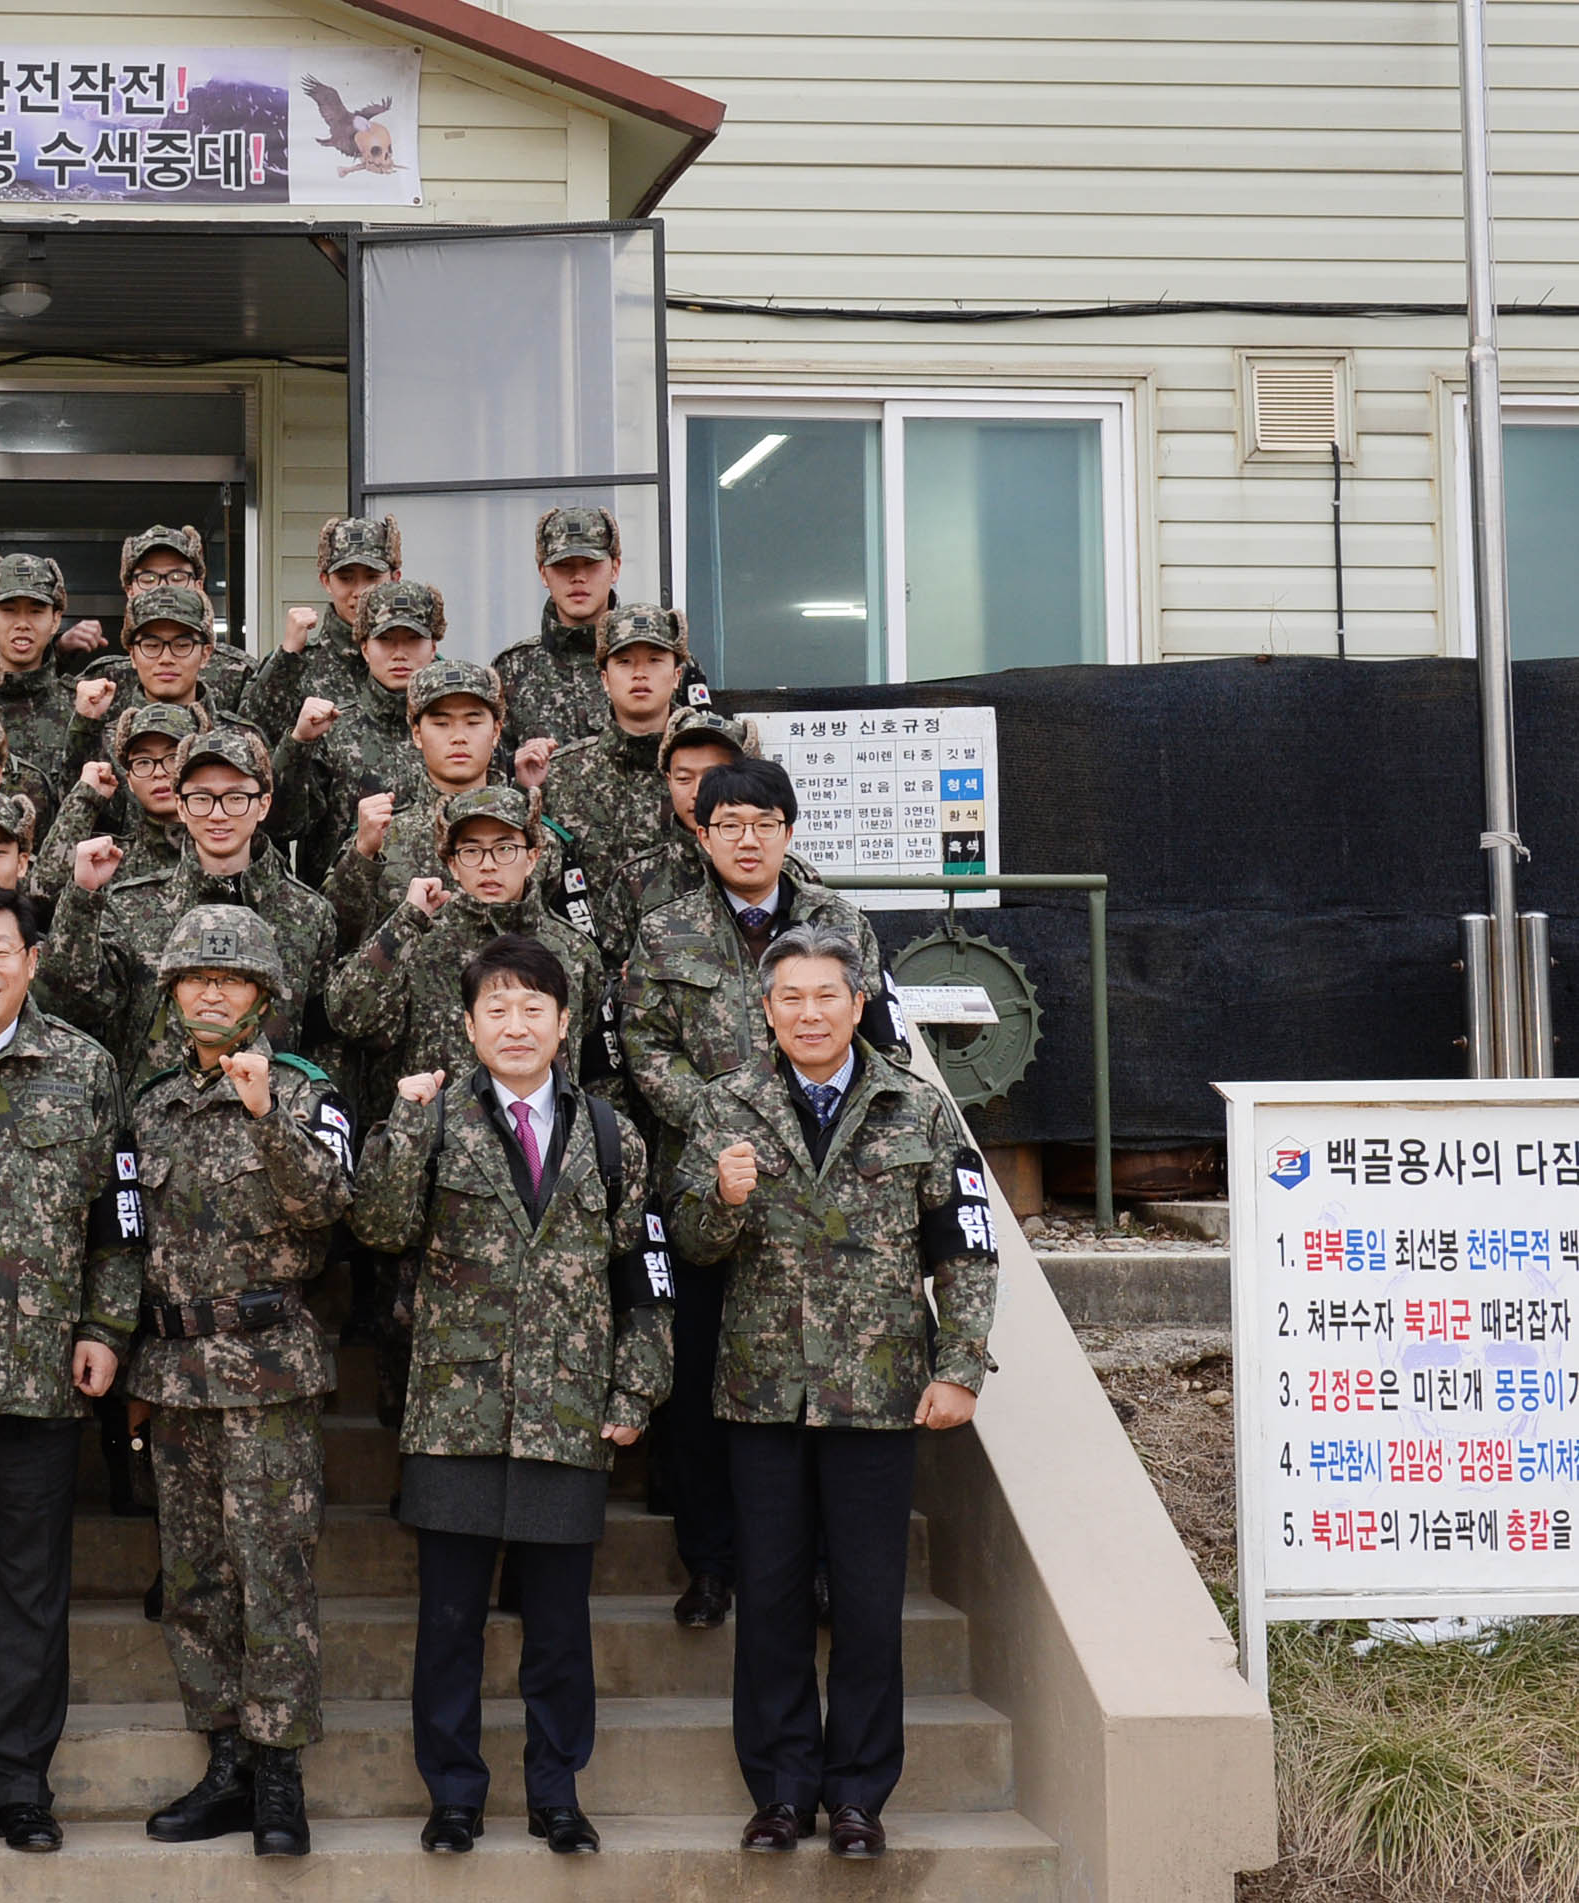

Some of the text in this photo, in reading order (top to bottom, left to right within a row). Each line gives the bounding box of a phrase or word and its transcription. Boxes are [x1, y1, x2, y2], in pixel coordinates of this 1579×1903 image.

[35, 130, 265, 188] 수색중대!
[856, 751, 893, 763] 싸이렌
[1327, 1137, 1579, 1186] 백골용사의 다짐
[1276, 1232, 1295, 1267] 1.
[1304, 1229, 1387, 1272] 멸북통일
[1395, 1228, 1459, 1272] 최선봉
[1467, 1229, 1550, 1271] 천하무적
[1278, 1298, 1571, 1341] 2. 쳐부수자 북괴군 때려잡자
[1279, 1371, 1299, 1407] 3.
[1309, 1369, 1400, 1412] 김정은은
[1413, 1368, 1483, 1411] 미친개
[1279, 1441, 1301, 1477] 4.
[1309, 1439, 1382, 1482] 부관참시
[1283, 1509, 1572, 1551] 5. 북괴군의 가슴팍에 총칼을
